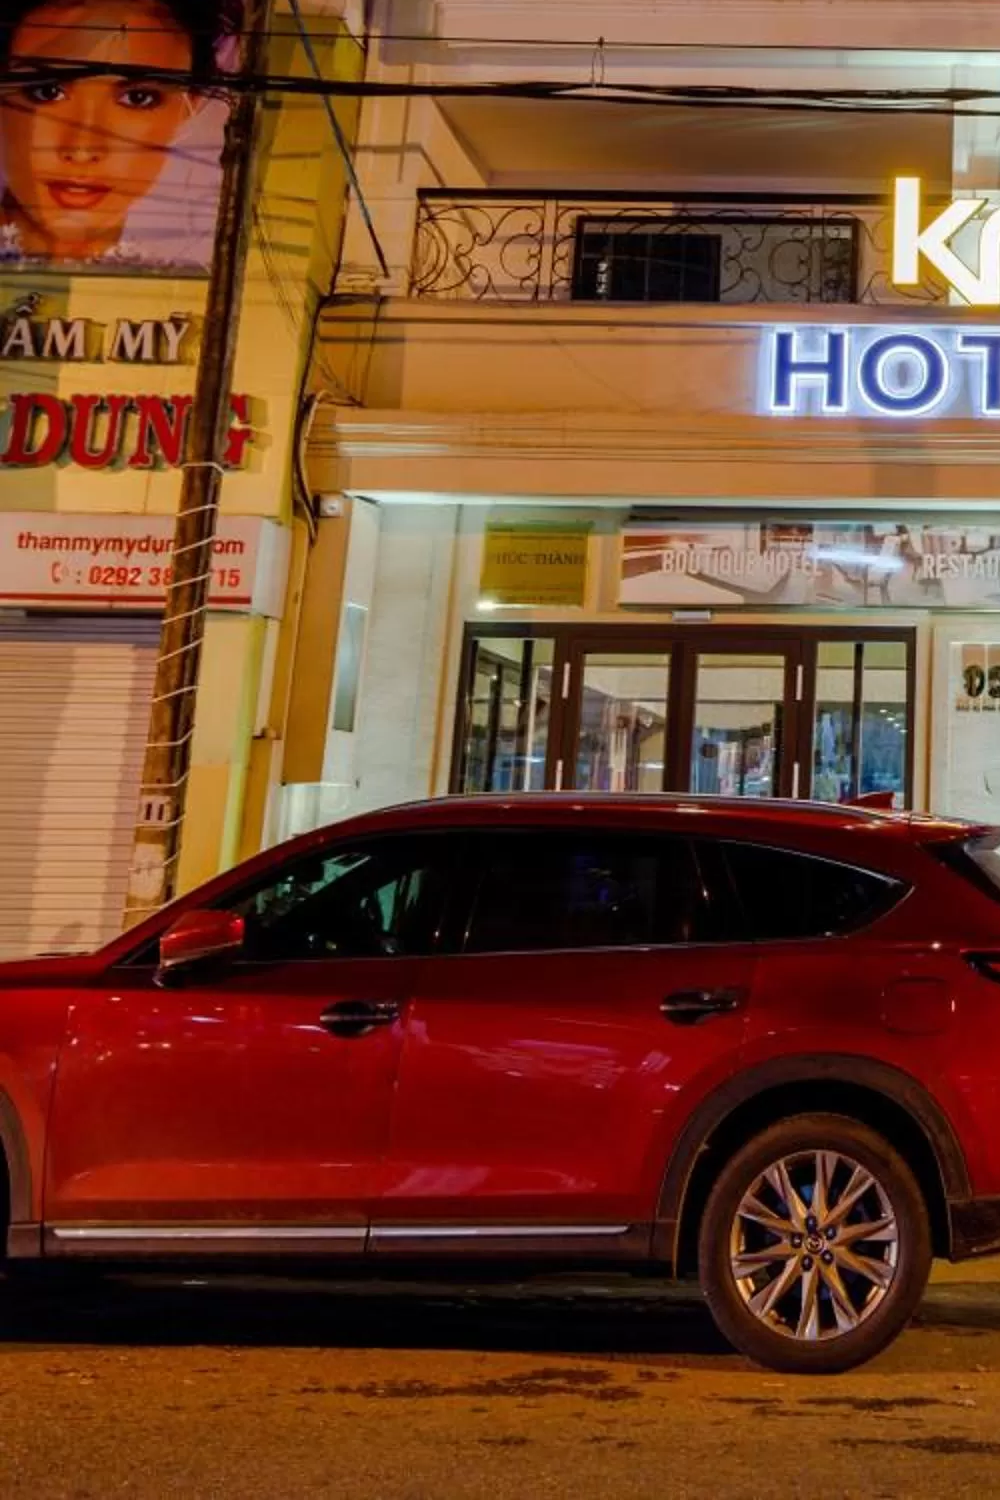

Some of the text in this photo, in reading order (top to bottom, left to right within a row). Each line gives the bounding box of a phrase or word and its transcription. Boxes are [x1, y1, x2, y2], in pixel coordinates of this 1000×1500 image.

[662, 548, 823, 577] BOUTIQUE HOTEL
[89, 566, 141, 586] 0292
